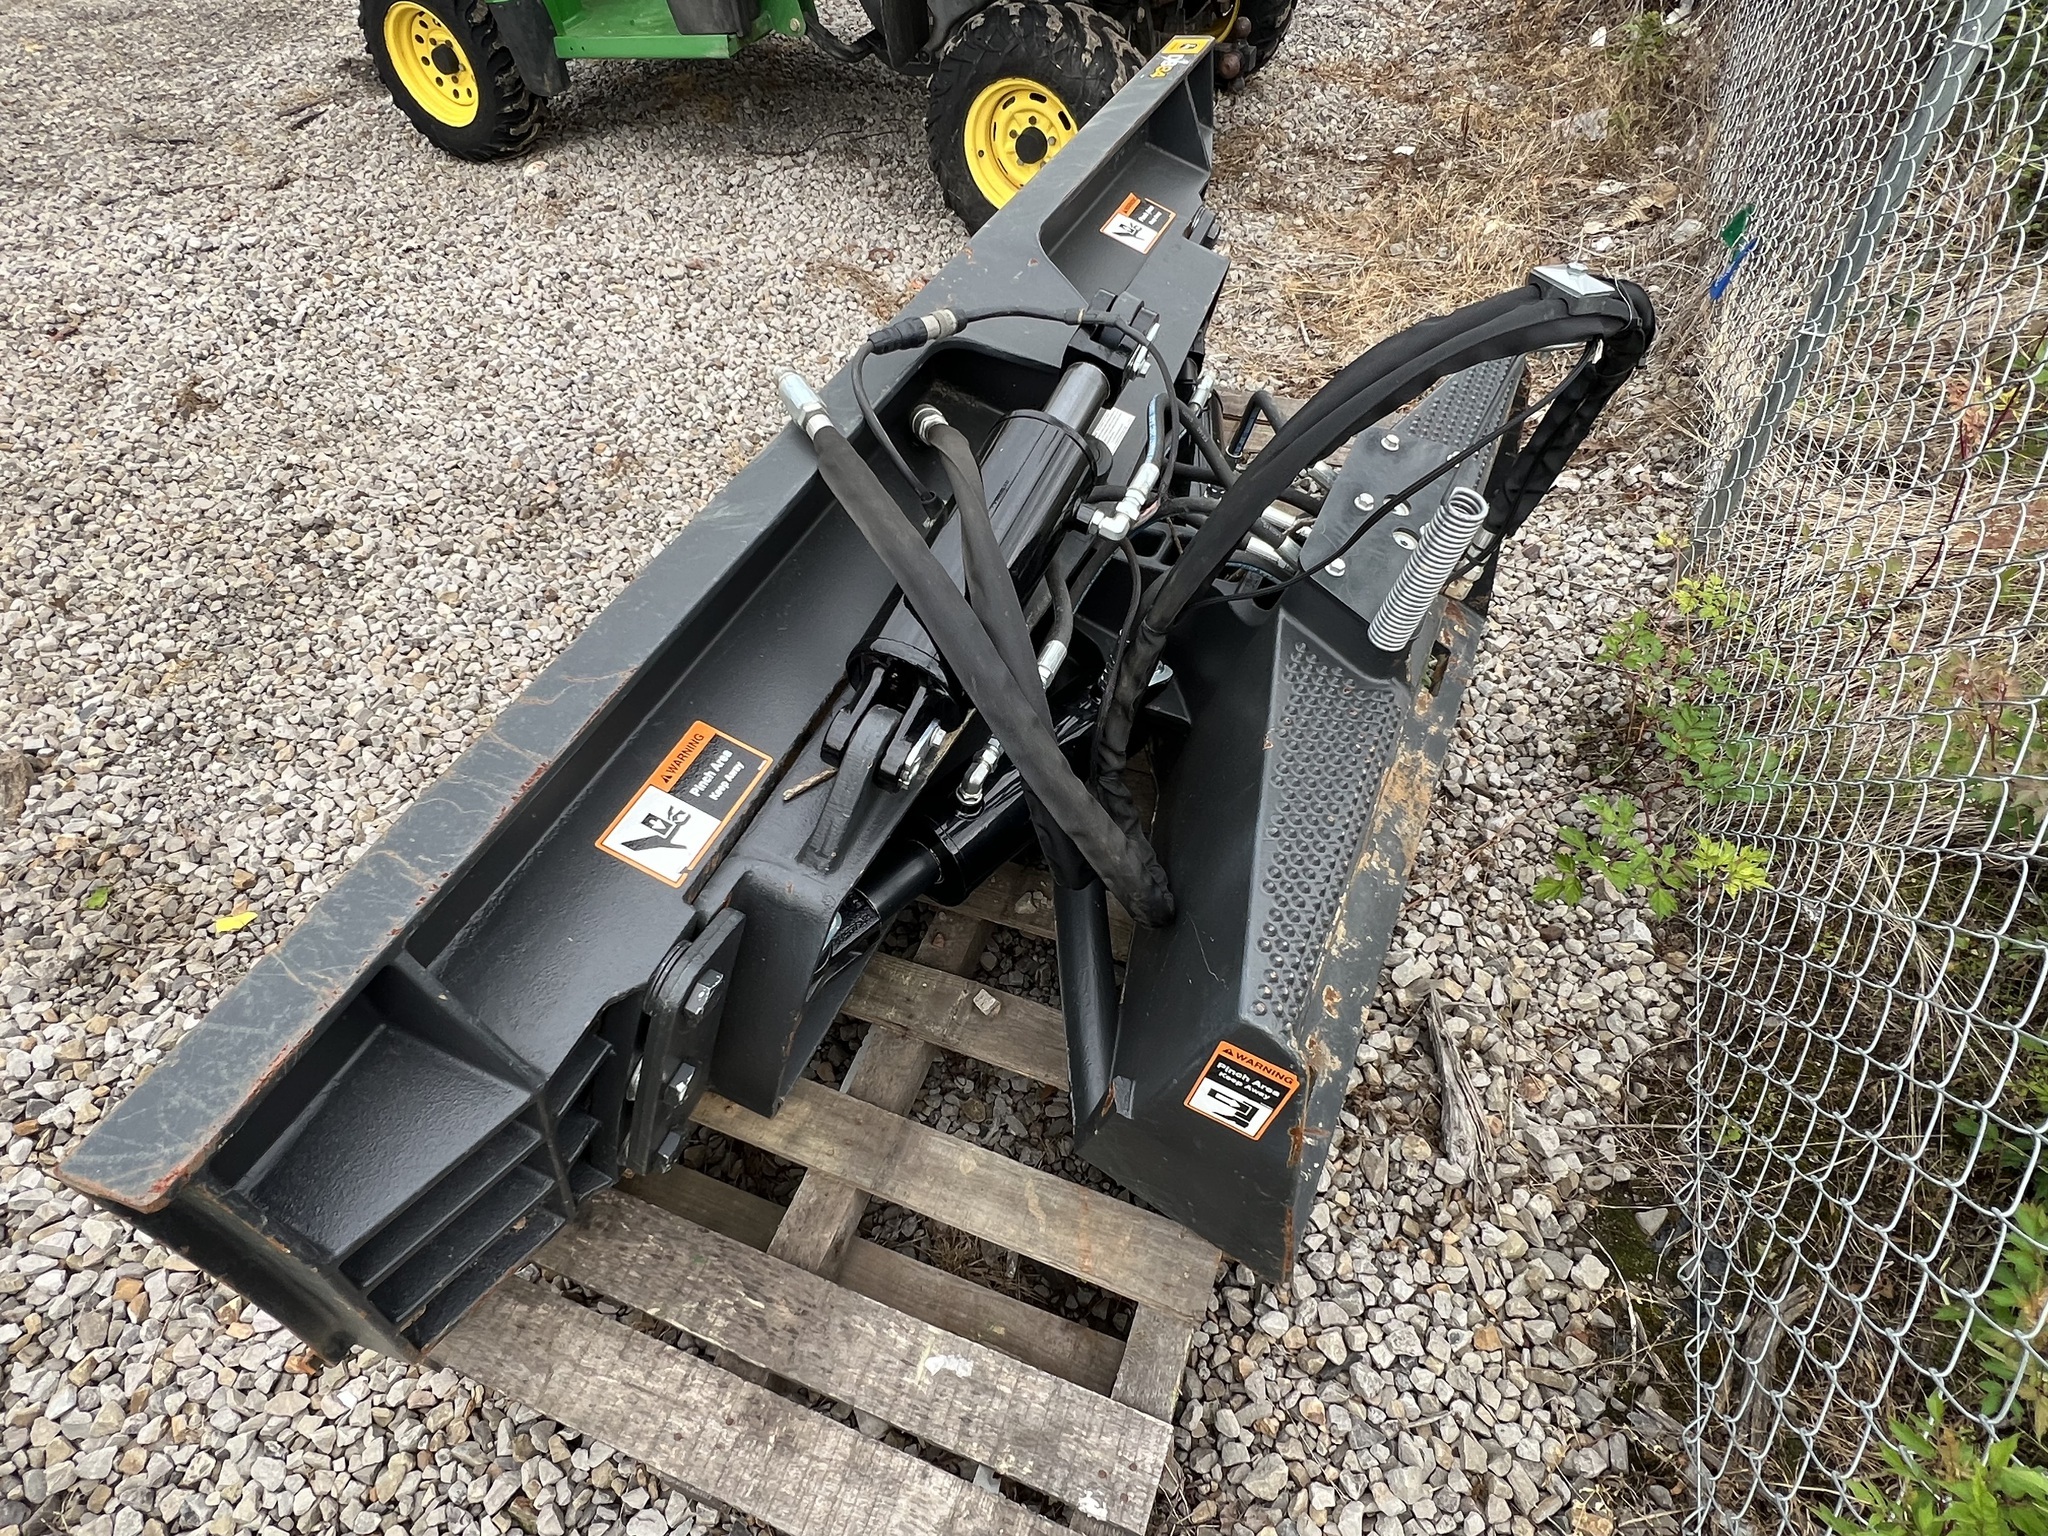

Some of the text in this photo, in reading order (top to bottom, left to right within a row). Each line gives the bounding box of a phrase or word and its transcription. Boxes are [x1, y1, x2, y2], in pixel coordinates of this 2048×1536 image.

[666, 733, 705, 775] WARNING
[689, 749, 733, 797] Pinch Area
[708, 761, 745, 801] Keep Away
[1216, 1061, 1280, 1098] Pinch Area
[1218, 1071, 1271, 1100] Keep Away
[1236, 1052, 1294, 1085] WARNING
